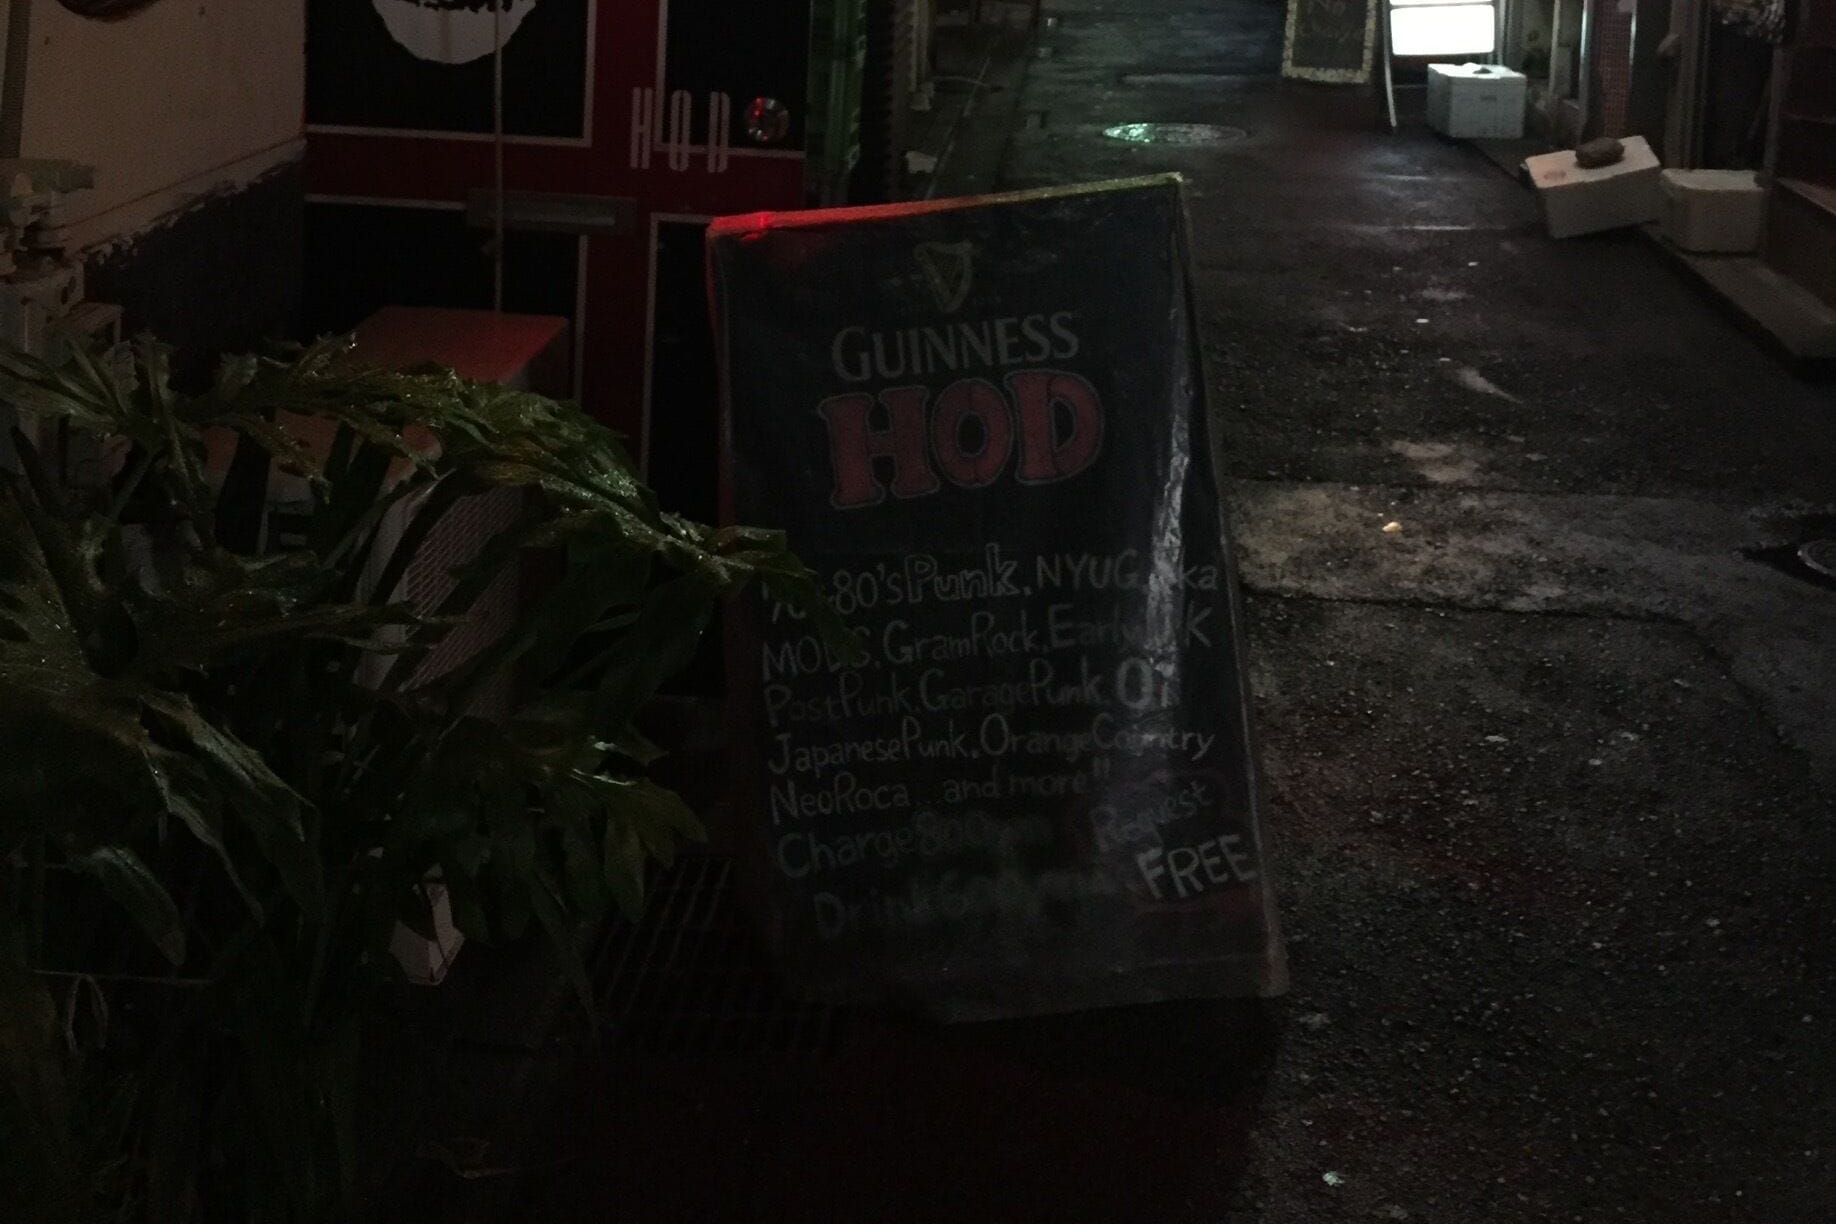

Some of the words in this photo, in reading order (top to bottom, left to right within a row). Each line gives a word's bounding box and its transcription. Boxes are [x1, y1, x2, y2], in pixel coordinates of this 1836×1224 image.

[831, 311, 1080, 382] GUINNESS
[816, 368, 1104, 510] HOD
[1136, 833, 1257, 900] FREE
